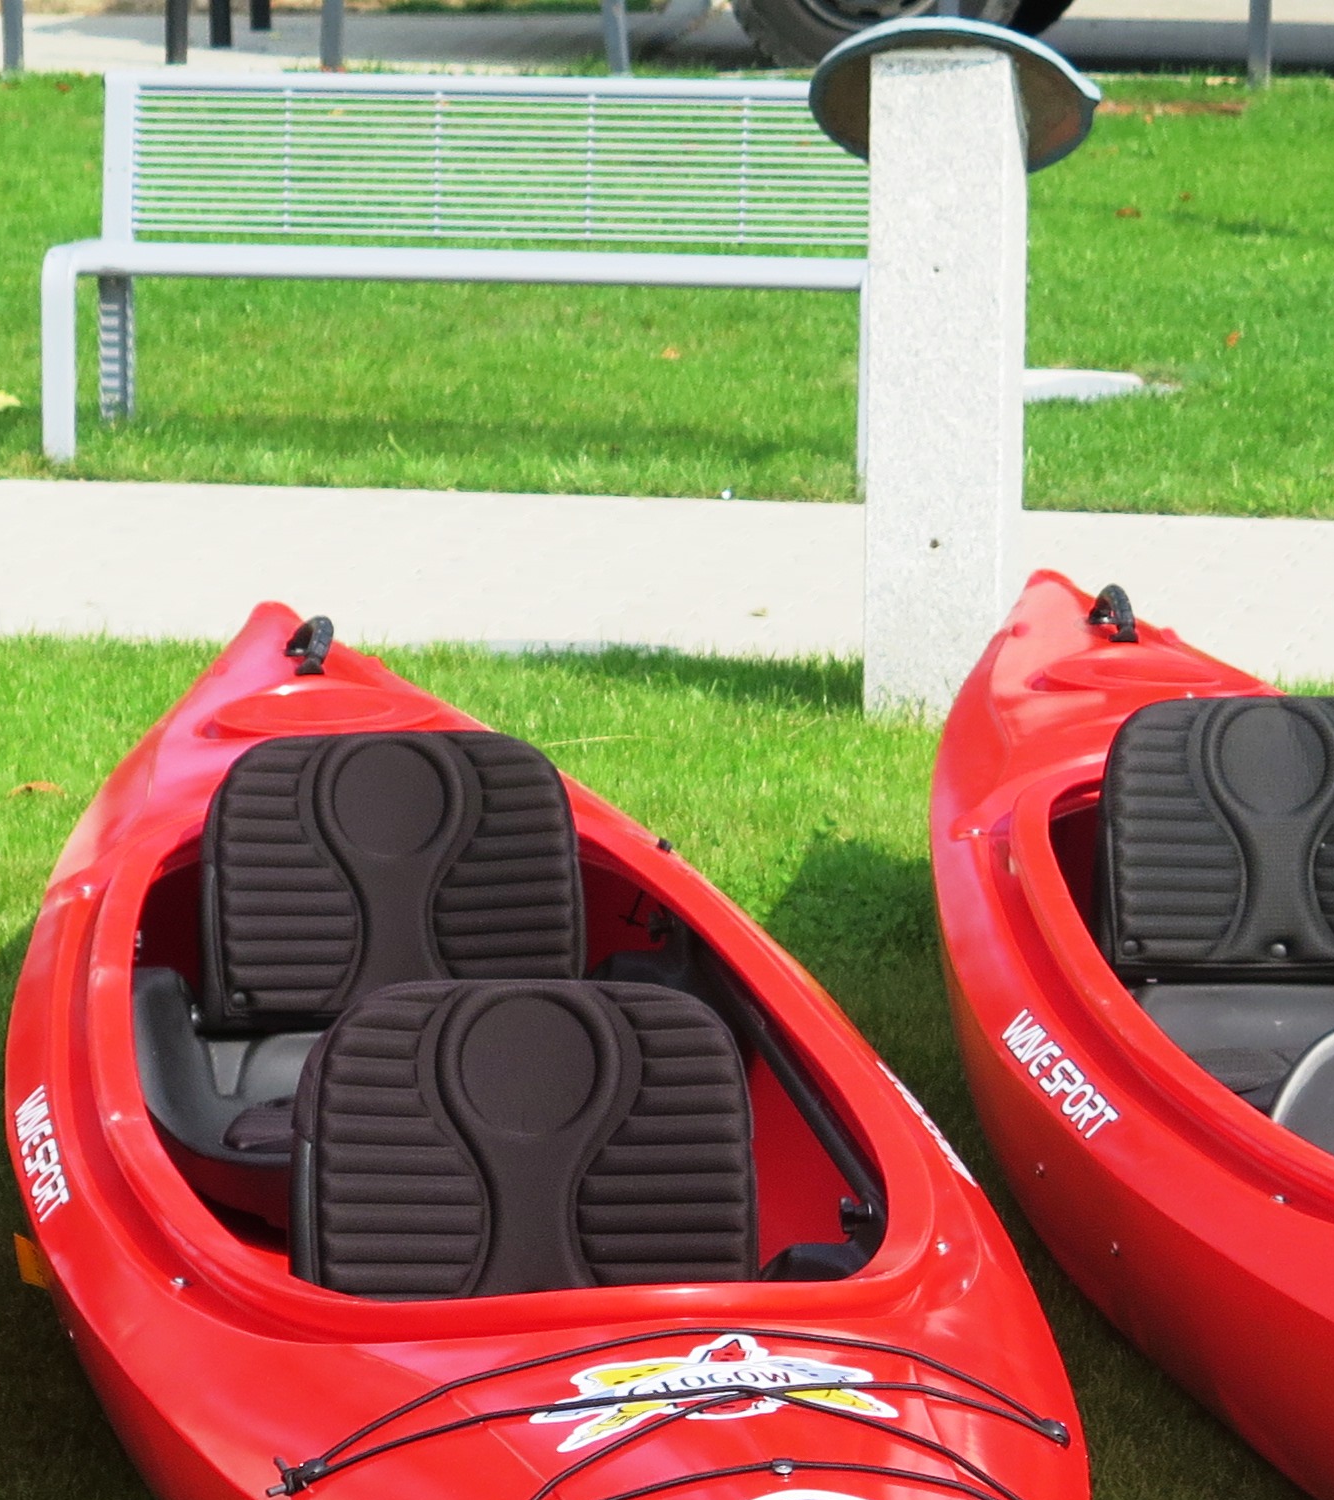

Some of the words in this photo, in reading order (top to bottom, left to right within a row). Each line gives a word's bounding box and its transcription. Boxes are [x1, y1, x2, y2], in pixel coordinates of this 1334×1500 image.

[1001, 1008, 1063, 1078] WAVE
[1038, 1058, 1120, 1139] SPORT
[14, 1084, 53, 1157] WAVE
[23, 1138, 70, 1223] SPORT
